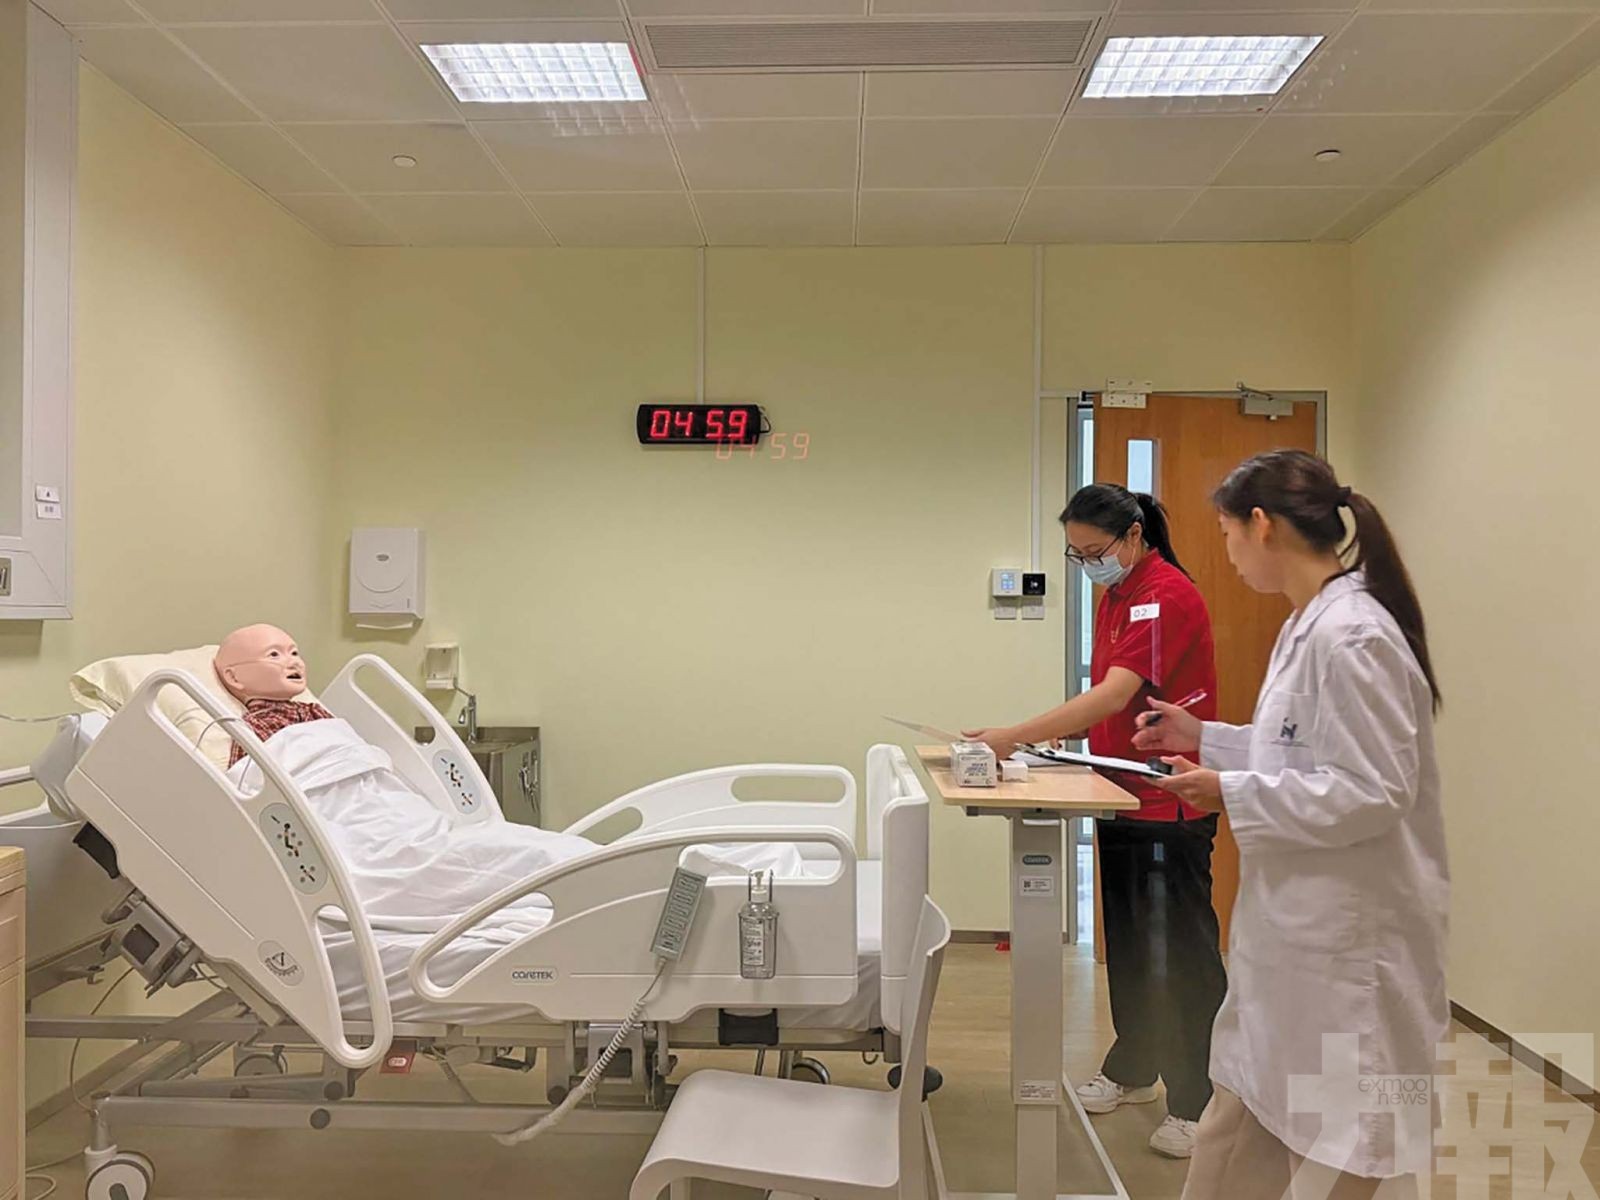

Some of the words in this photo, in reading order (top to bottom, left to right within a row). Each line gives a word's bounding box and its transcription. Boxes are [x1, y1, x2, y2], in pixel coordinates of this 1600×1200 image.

[650, 410, 693, 438] 04
[705, 410, 748, 438] 59
[1133, 607, 1148, 618] 02
